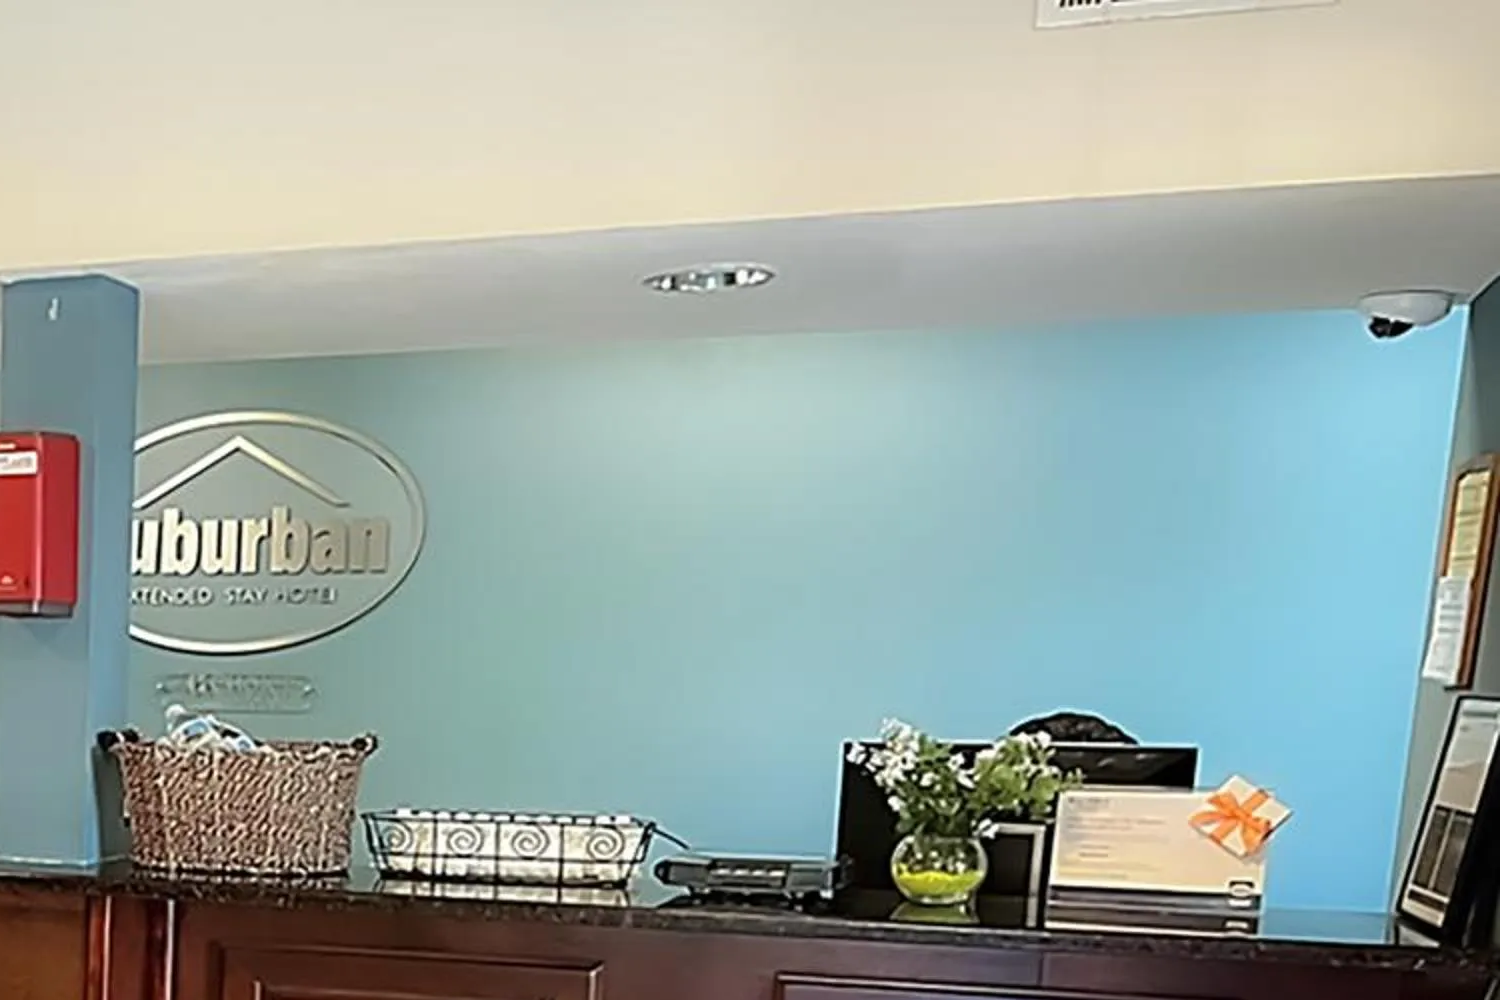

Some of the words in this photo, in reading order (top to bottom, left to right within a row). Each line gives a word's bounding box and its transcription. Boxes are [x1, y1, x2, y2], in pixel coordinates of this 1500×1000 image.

[132, 506, 389, 575] uburban
[225, 587, 269, 605] STAY
[278, 587, 338, 604] HOTEL
